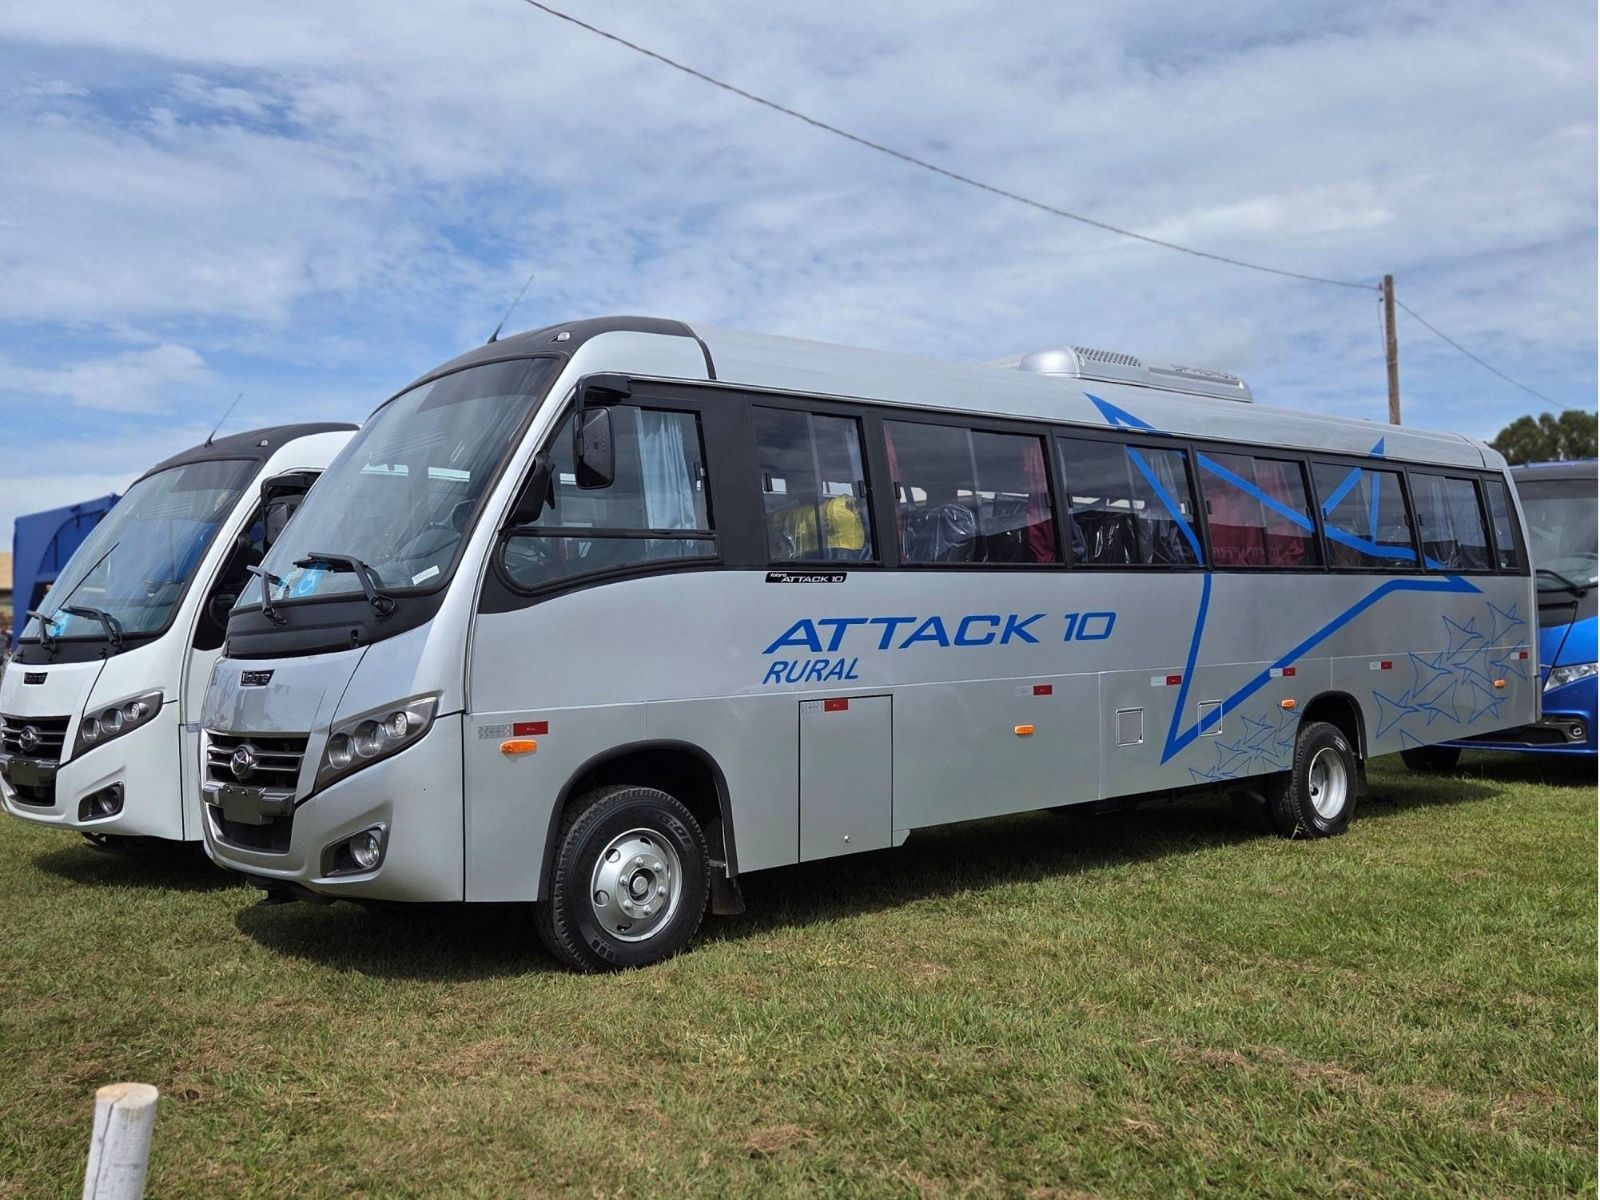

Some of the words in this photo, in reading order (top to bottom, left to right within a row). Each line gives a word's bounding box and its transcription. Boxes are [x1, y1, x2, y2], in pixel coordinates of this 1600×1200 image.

[762, 614, 1047, 654] ATTACK
[1063, 612, 1116, 641] 10
[763, 657, 859, 685] RURAL
